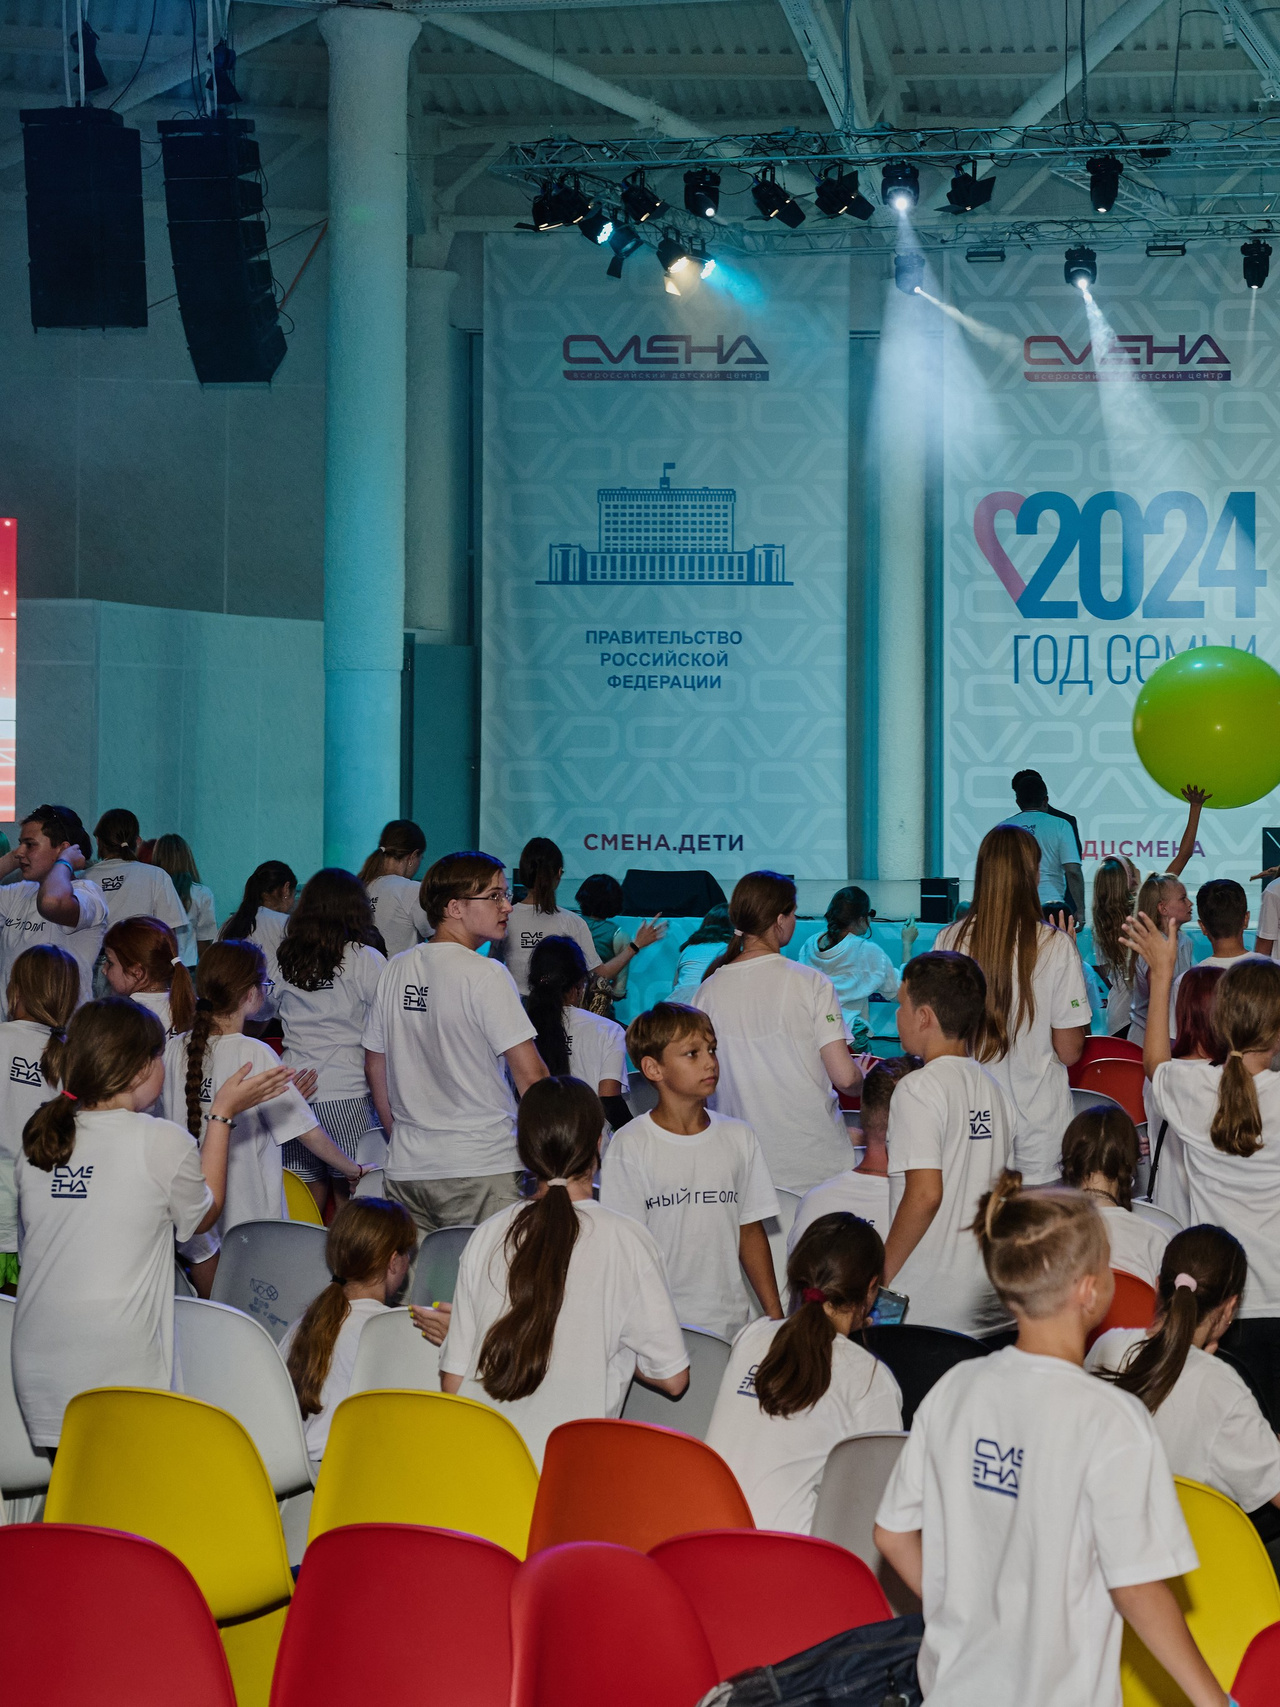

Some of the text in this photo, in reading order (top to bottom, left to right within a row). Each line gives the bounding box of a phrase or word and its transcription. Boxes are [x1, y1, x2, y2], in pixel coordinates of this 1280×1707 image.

[563, 334, 769, 364] СМЕНА
[573, 370, 762, 381] всероссийский детский центр
[1189, 371, 1224, 381] центр
[1016, 490, 1267, 620] 2024
[586, 630, 743, 645] ПРАВИТЕЛЬСТВО
[601, 650, 728, 667] РОССИЙСКОЙ
[1013, 634, 1093, 695] ГОД
[607, 674, 722, 691] ФЕДЕРАЦИИ
[583, 833, 743, 854] СМЕНА.ДЕТИ
